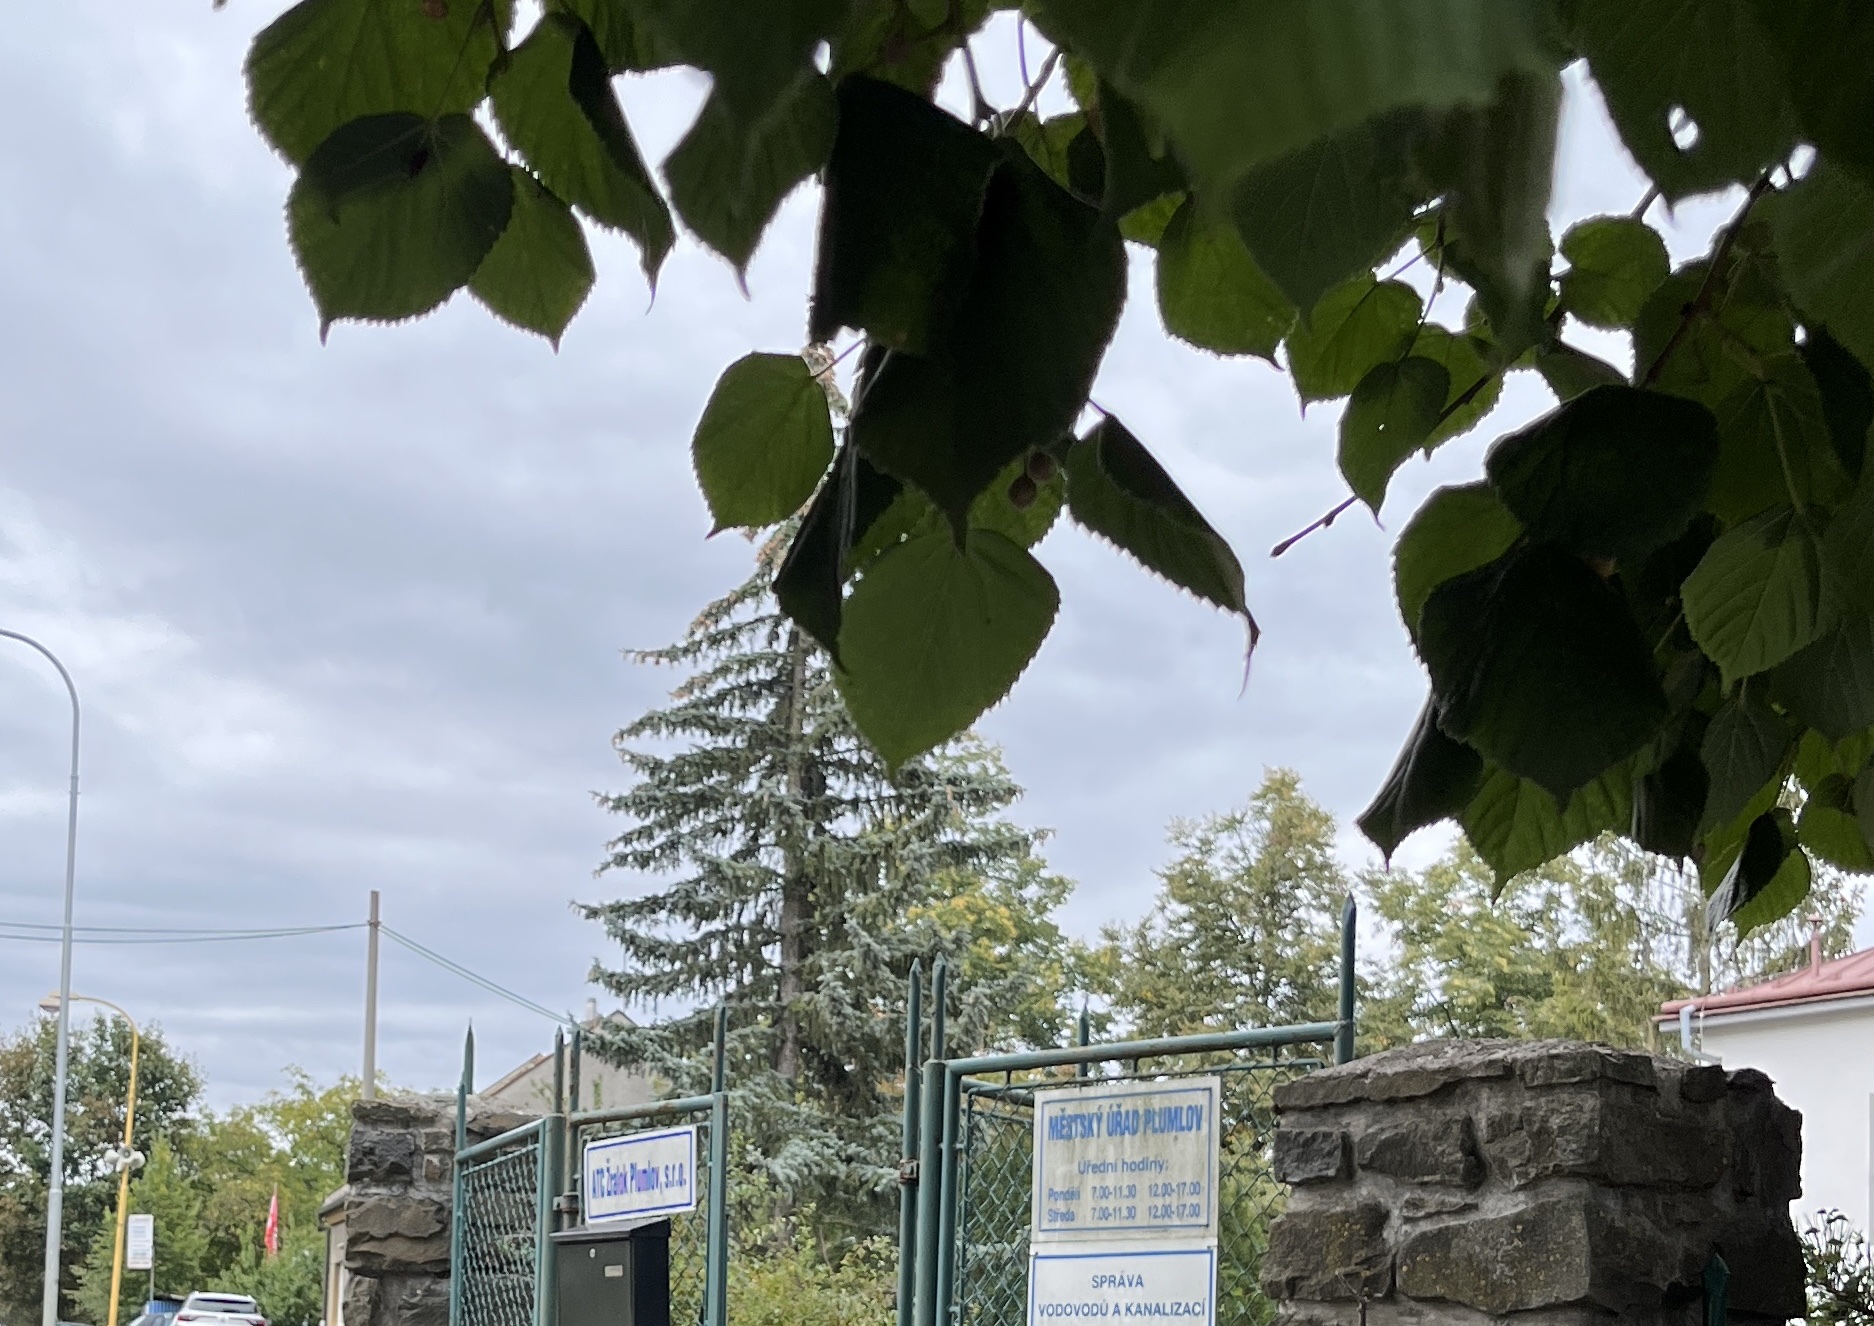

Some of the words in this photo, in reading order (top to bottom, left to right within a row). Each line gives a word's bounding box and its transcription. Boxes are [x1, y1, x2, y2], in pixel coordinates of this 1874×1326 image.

[1048, 1106, 1102, 1140] MĚSTSKÝ
[1106, 1105, 1139, 1137] ÚŘAD
[1143, 1105, 1203, 1134] PLUMLOV
[1078, 1157, 1118, 1174] Úřední
[630, 1160, 662, 1194] Plumlov,
[664, 1161, 686, 1188] s.r.o.
[1092, 1184, 1136, 1200] 7.00-11.30
[1148, 1182, 1201, 1197] 12.00-17.00
[1091, 1206, 1136, 1221] 7.00-11.30
[1148, 1203, 1200, 1219] 12.00-17.00
[1092, 1269, 1144, 1288] SPRÁVA
[1039, 1297, 1108, 1317] VODOVODŮ
[1112, 1303, 1121, 1317] A
[1125, 1297, 1206, 1317] KANALIZACÍ
